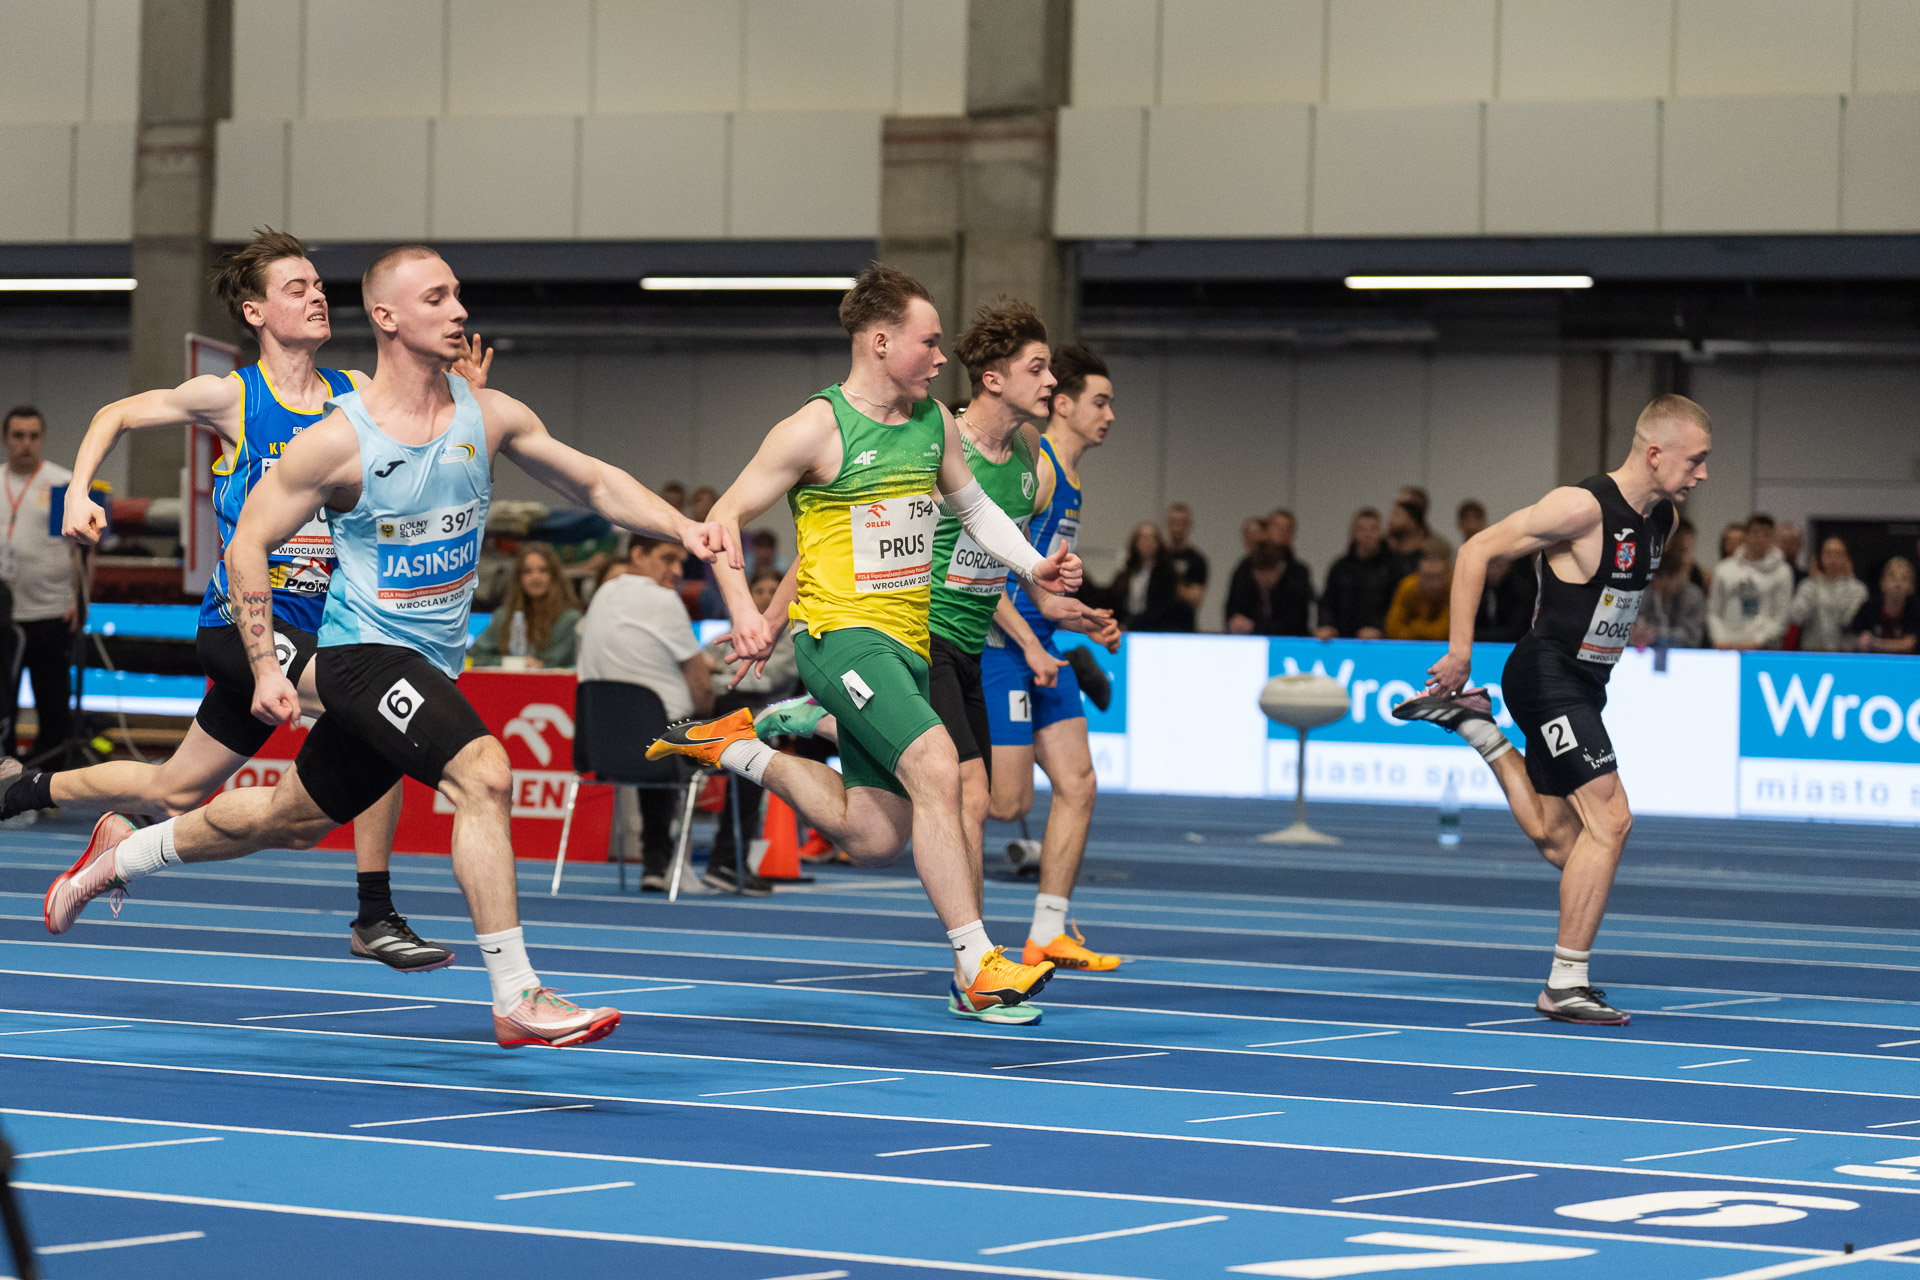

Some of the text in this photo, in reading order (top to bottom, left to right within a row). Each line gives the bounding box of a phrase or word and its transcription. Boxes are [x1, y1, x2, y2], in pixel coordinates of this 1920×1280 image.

[441, 507, 474, 533] 397
[908, 500, 934, 520] 754
[400, 519, 428, 531] DOLNY
[865, 520, 891, 528] ORLEN
[279, 547, 325, 555] WROCŁAW
[382, 540, 474, 578] JASIŃSKI
[879, 533, 925, 559] PRUS
[872, 578, 917, 590] WROCŁAW
[396, 595, 449, 610] WROCŁAW
[386, 689, 413, 720] 6
[1019, 692, 1028, 719] 1
[1548, 722, 1570, 752] 2
[1757, 773, 1890, 806] miasto
[1554, 1190, 1860, 1227] 6
[1225, 1231, 1599, 1279] 7
